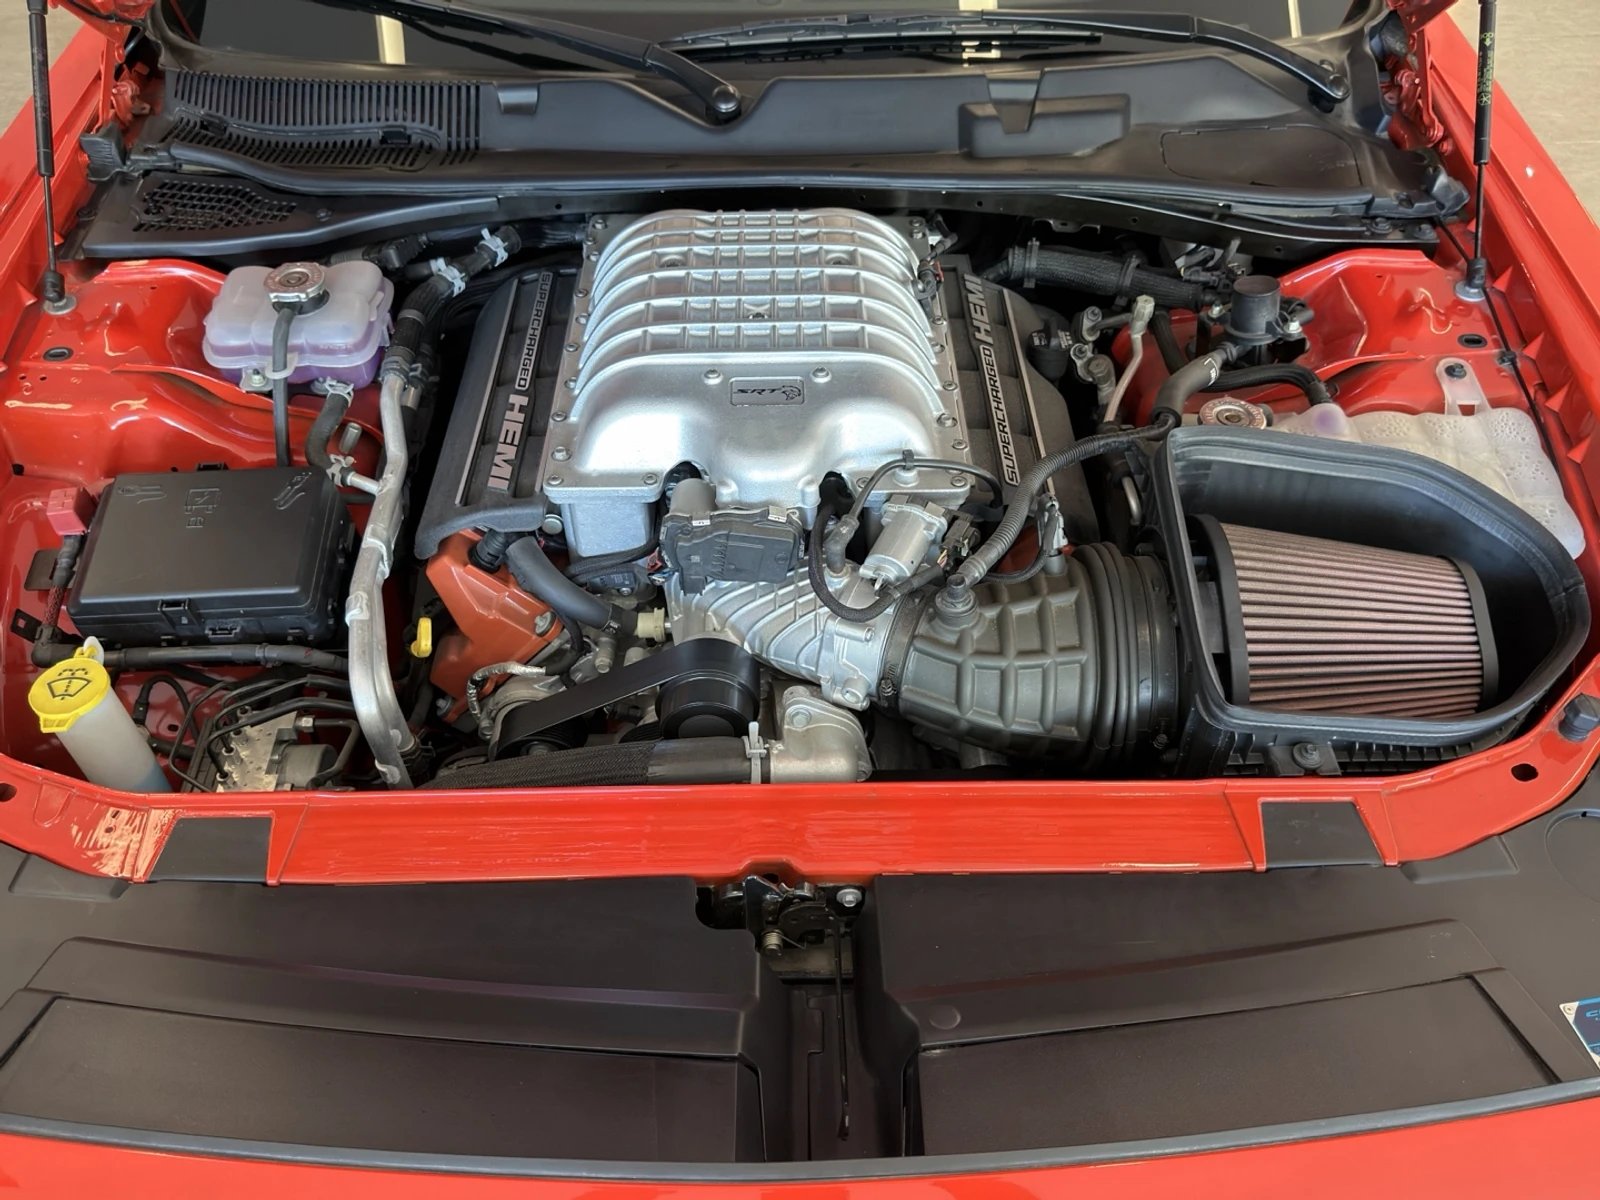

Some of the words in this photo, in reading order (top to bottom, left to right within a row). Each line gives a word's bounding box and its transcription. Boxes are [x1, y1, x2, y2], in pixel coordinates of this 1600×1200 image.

[516, 272, 552, 389] SUPERCHARGED
[963, 273, 994, 345] HEMI
[733, 388, 782, 396] SRT
[981, 346, 1020, 486] SUPERCHARGED
[487, 394, 529, 491] HEMI
